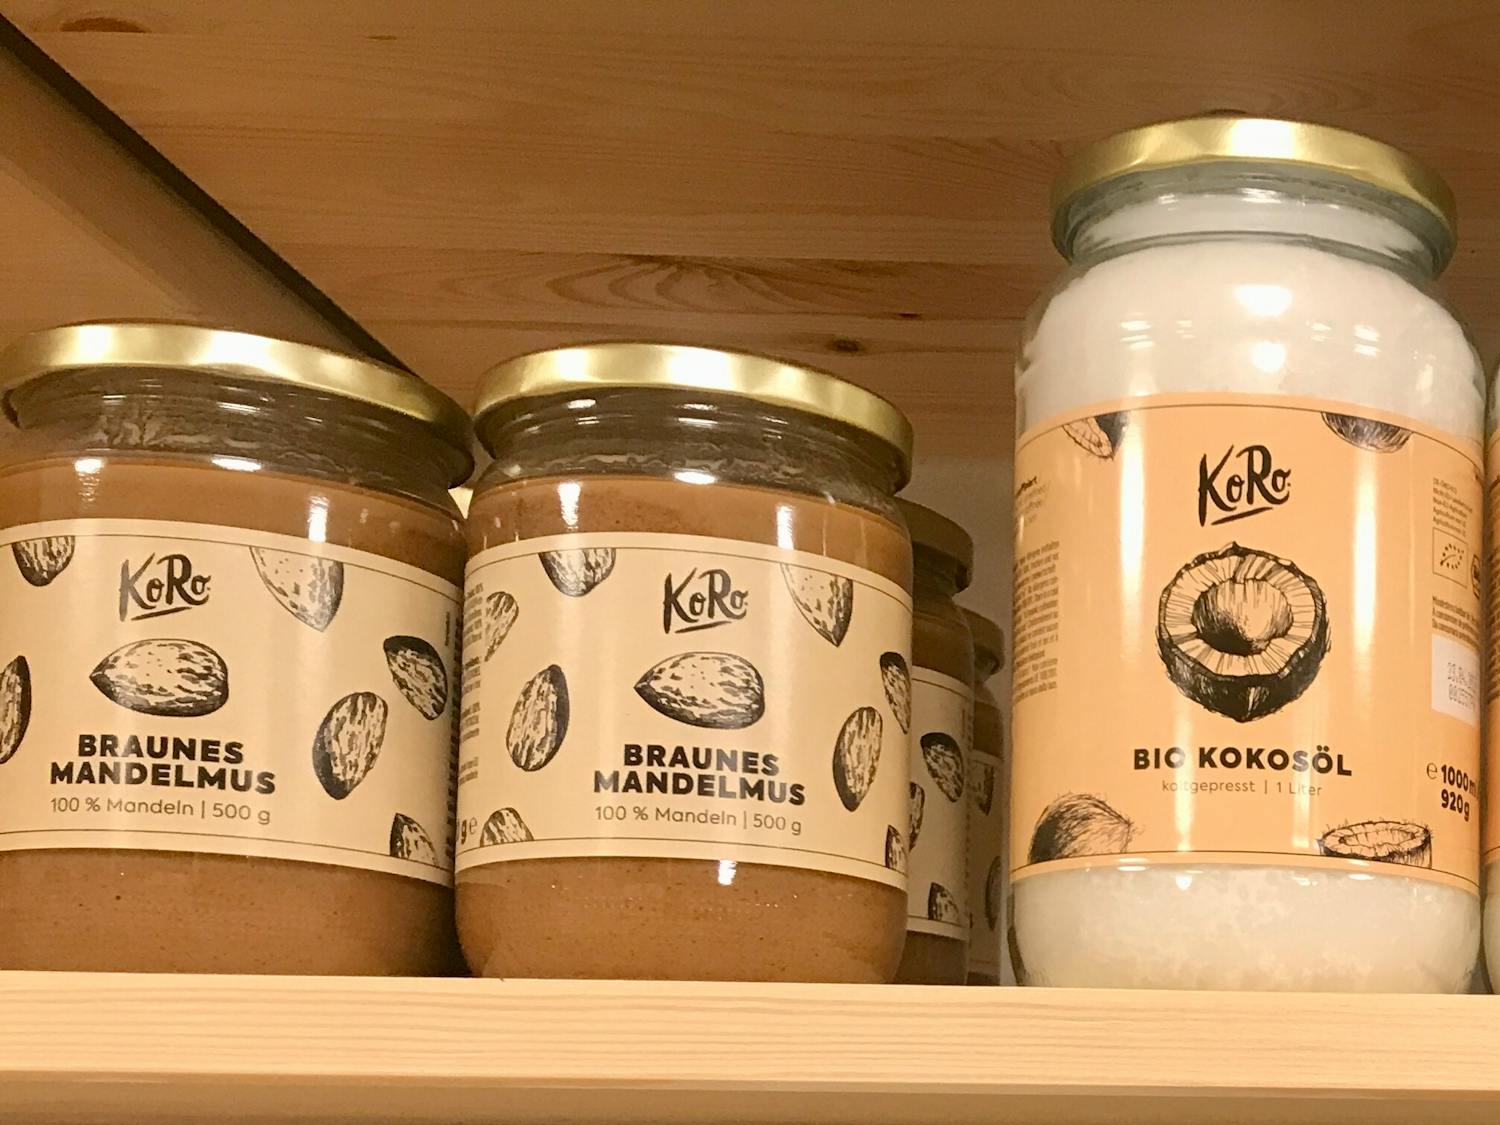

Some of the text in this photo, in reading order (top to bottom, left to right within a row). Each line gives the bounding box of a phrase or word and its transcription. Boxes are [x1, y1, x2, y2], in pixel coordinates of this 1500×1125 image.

[1198, 444, 1291, 526] KoRo
[119, 553, 211, 622] KoRo
[663, 567, 748, 634] KoRo
[78, 734, 244, 764] BRAUNES
[623, 743, 780, 776] BRAUNES
[1133, 744, 1352, 776] BIO KOKOSÖL
[50, 761, 276, 795] MANDELMUS
[593, 770, 805, 806] MANDELMUS
[1288, 780, 1322, 797] Liter
[51, 797, 80, 813] 100
[84, 797, 101, 813] %
[106, 797, 194, 817] Mandeln
[212, 803, 251, 820] 500
[257, 808, 271, 825] g
[596, 805, 627, 822] 100
[632, 806, 649, 822] %
[654, 807, 737, 827] Mandeln
[752, 812, 787, 831] 500
[790, 819, 802, 836] g
[1441, 789, 1470, 822] 920g
